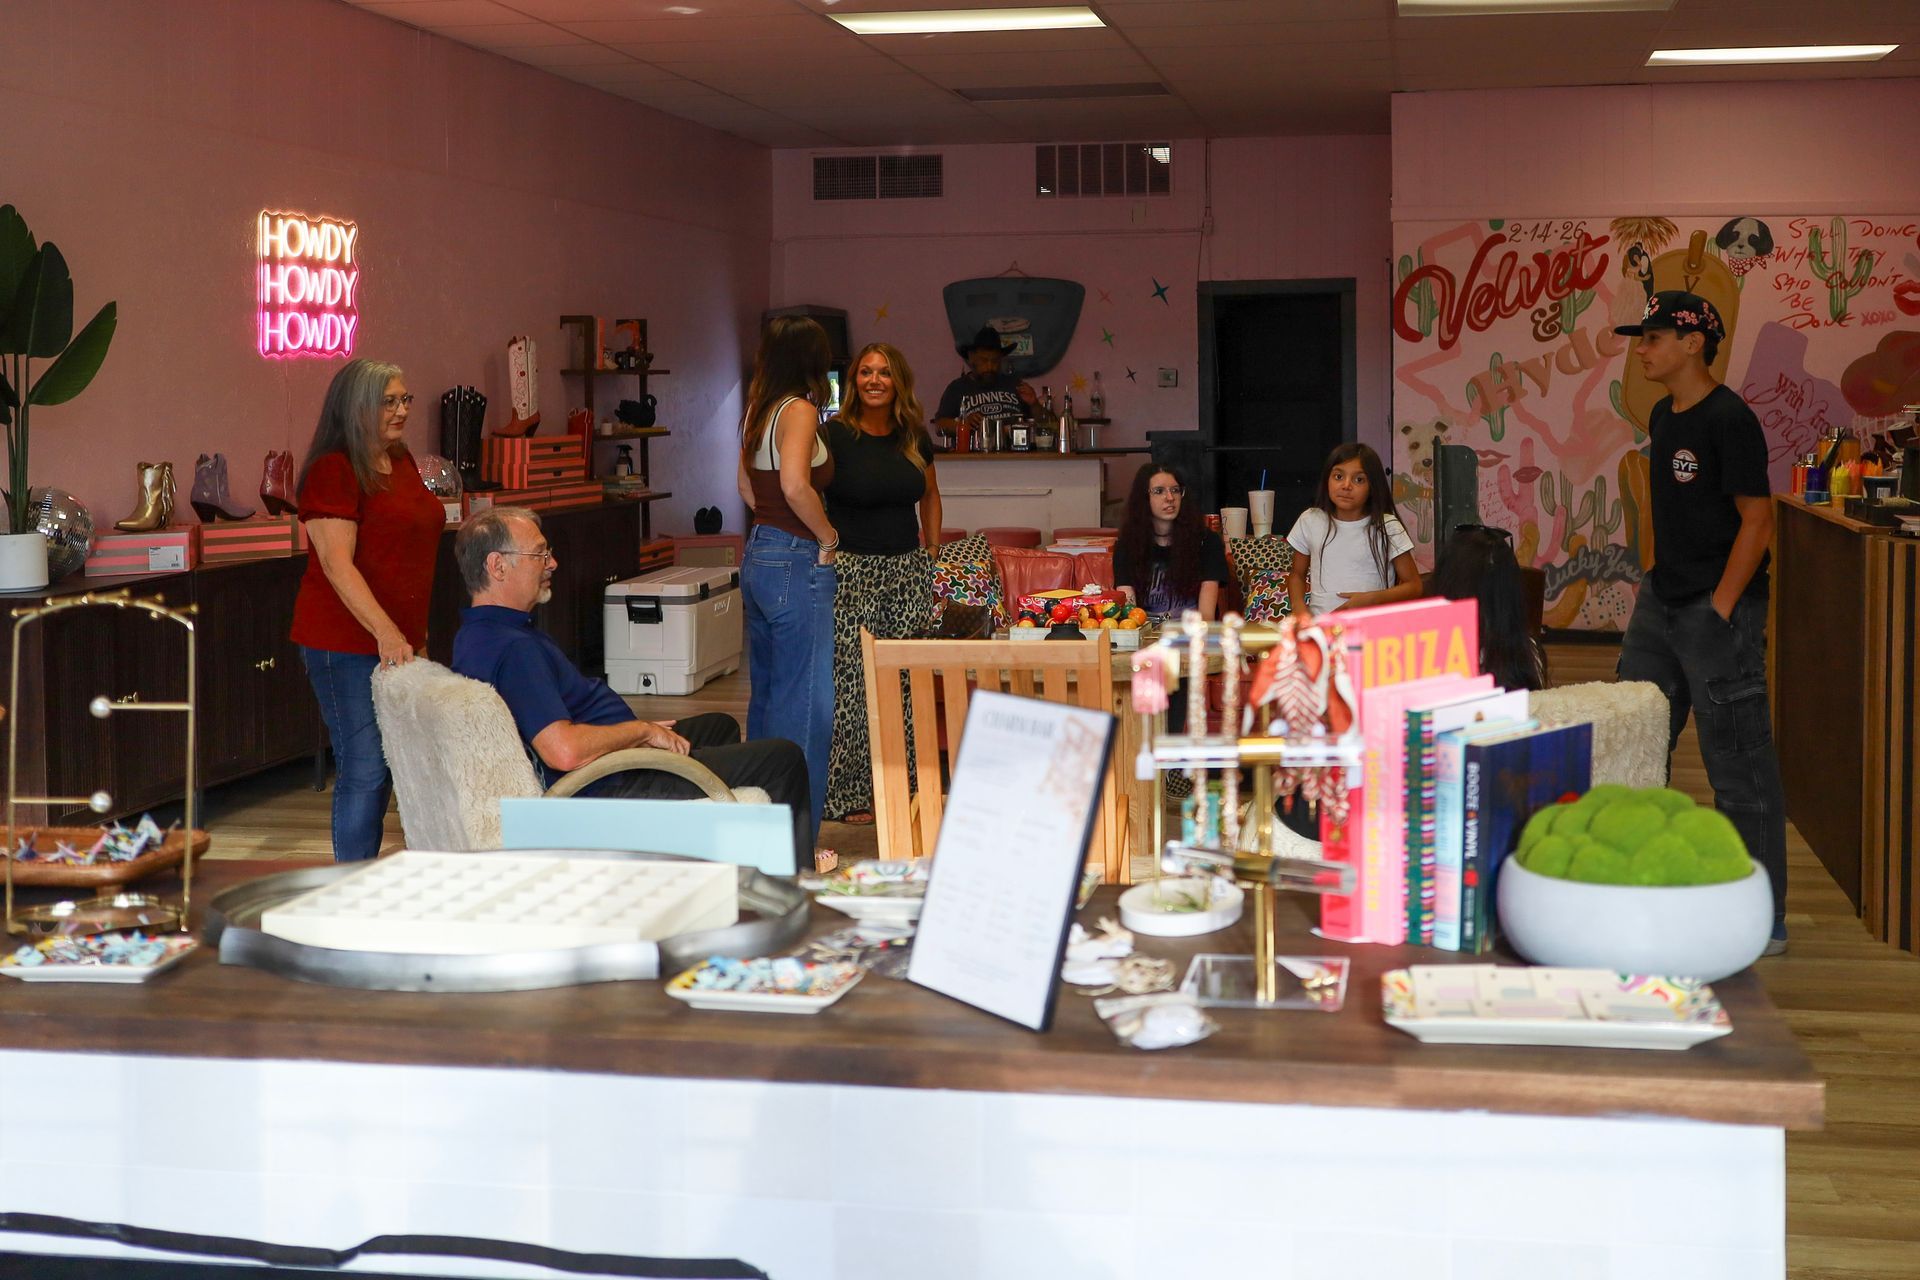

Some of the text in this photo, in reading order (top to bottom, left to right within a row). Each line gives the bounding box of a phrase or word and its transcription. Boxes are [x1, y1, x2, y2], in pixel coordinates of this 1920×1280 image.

[263, 216, 356, 263] HOWDY
[1849, 219, 1918, 237] DOING
[263, 264, 357, 307] HOWDY
[1393, 232, 1610, 350] Velvet
[1772, 272, 1811, 292] SAID
[1779, 292, 1815, 311] BE
[263, 311, 356, 352] HOWDY
[1530, 303, 1562, 342] &
[1777, 312, 1856, 329] DONE
[1672, 459, 1699, 472] SYF
[1543, 544, 1641, 600] Lucky You
[1363, 626, 1472, 689] IBIZA
